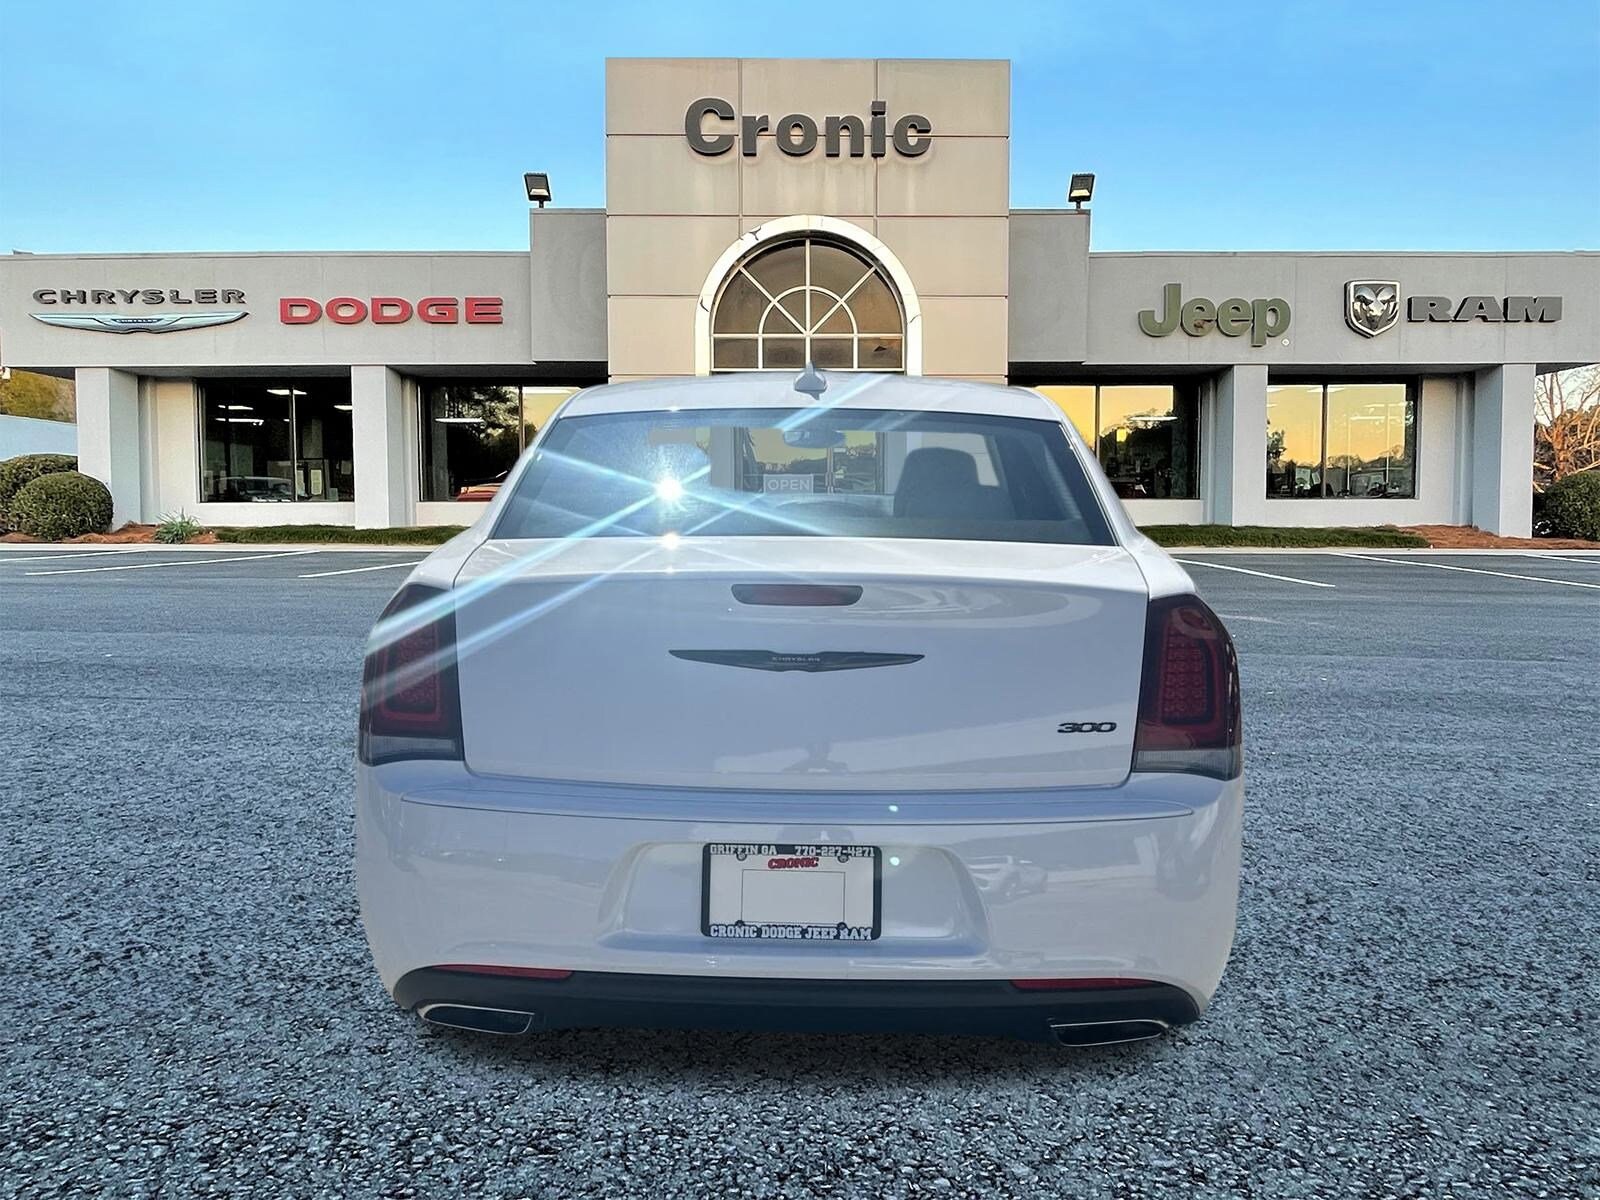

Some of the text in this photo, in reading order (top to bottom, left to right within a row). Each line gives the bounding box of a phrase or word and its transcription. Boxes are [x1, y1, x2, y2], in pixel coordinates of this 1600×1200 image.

[685, 98, 932, 158] Cronic
[32, 289, 248, 304] CHRYSLER
[280, 297, 503, 325] DODGE
[1138, 283, 1291, 347] Jeep
[1407, 296, 1563, 322] RAM
[767, 479, 810, 490] OPEN
[1057, 722, 1117, 733] 300
[710, 844, 875, 857] GRIFFIN GA 770-227-4271
[710, 924, 872, 940] CRONIC DODGE JEEP RAM
